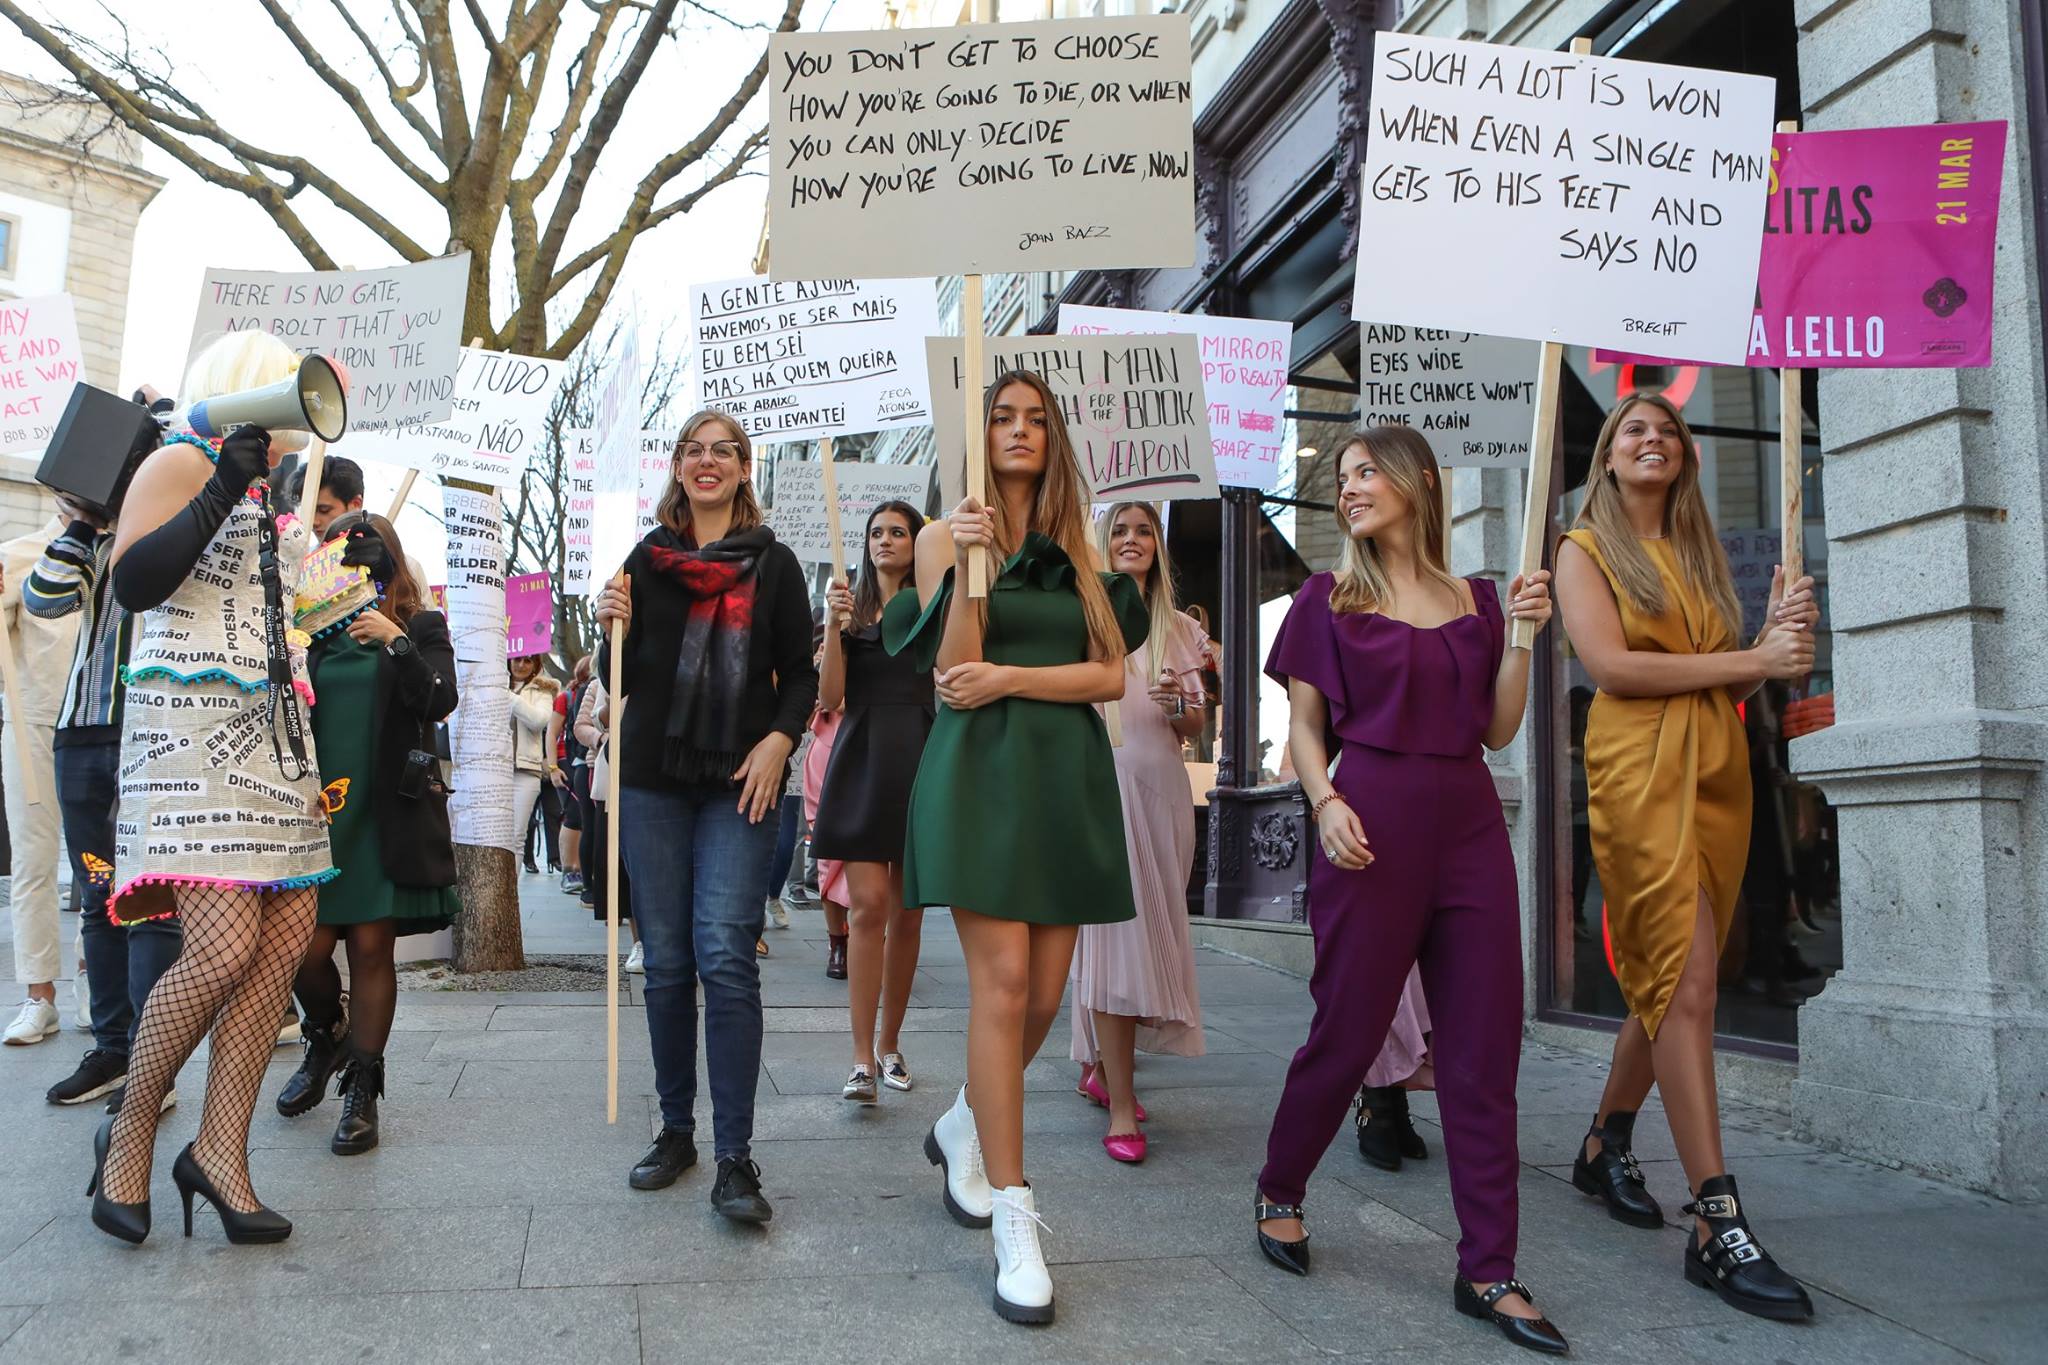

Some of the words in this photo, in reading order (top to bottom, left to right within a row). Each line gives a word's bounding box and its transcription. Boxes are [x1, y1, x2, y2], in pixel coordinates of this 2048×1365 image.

[782, 51, 832, 92] YOU
[851, 40, 935, 74] DON'T
[947, 40, 999, 67] GET
[1012, 37, 1036, 63] TO
[1054, 33, 1159, 60] CHOOSE
[1386, 48, 1466, 86] SUCH
[1478, 57, 1502, 93] A
[1517, 60, 1576, 100] LOT
[1590, 67, 1624, 106] IS
[1648, 78, 1720, 118] WON
[790, 91, 849, 123] HOW
[855, 88, 923, 126] YOU'RE
[936, 84, 998, 109] GOING
[1092, 82, 1121, 103] OR
[1128, 80, 1190, 103] WHEN
[786, 138, 831, 168] YOU
[846, 134, 894, 155] CAN
[907, 129, 966, 161] ONLY
[980, 119, 1070, 147] DECIDE
[1380, 104, 1457, 145] WHEN
[1470, 116, 1539, 156] EVEN
[1553, 128, 1574, 161] A
[1593, 134, 1695, 172] SINGLE
[1712, 150, 1762, 181] MAN
[1938, 137, 1973, 189] MAR
[791, 172, 849, 208] HOW
[860, 165, 936, 208] YOU'RE
[959, 157, 1034, 187] GOING
[1044, 154, 1073, 178] TO
[1372, 165, 1430, 202] GETS
[1445, 167, 1480, 203] TO
[1496, 172, 1542, 206] HIS
[1559, 175, 1630, 212] FEET
[1651, 197, 1721, 226] AND
[1936, 201, 1967, 225] 21
[1019, 232, 1053, 250] JOAN
[1559, 229, 1638, 271] SAYS
[1654, 236, 1696, 273] NO
[211, 281, 274, 306] THERE
[284, 285, 306, 304] IS
[313, 285, 343, 307] NO
[701, 292, 712, 315] A
[721, 282, 785, 311] GENTE
[271, 318, 326, 336] BOLT
[337, 310, 394, 339] THAT
[398, 309, 441, 339] YOU
[700, 316, 771, 341] HAVEMOS
[779, 313, 797, 330] DE
[808, 306, 838, 323] SER
[853, 295, 897, 317] MAIS
[1622, 318, 1687, 336] BRECHT
[1368, 325, 1406, 343] AND
[1786, 316, 1883, 359] LELLO
[19, 338, 60, 361] AND
[389, 342, 424, 368] THE
[703, 348, 724, 370] EU
[734, 341, 768, 364] BEM
[776, 331, 802, 357] SEI
[1203, 336, 1282, 362] MIRROR
[1371, 353, 1408, 375] EYES
[1418, 348, 1463, 371] WIDE
[35, 361, 77, 381] WAY
[473, 355, 548, 394] TUDO
[704, 375, 744, 398] MAS
[753, 363, 776, 389] HÁ
[783, 360, 830, 384] QUEM
[839, 348, 896, 375] QUEIRA
[1103, 347, 1179, 384] MAN
[364, 383, 395, 413] MY
[405, 376, 453, 402] MIND
[879, 388, 911, 400] ZECA
[1217, 363, 1235, 384] TO
[1240, 367, 1287, 401] REALITY
[1366, 383, 1405, 405] THE
[1410, 382, 1475, 402] CHANCE
[1481, 381, 1534, 404] WON'T
[5, 396, 42, 419] ACT
[754, 393, 796, 411] ABAIXO
[877, 401, 919, 415] AFONSO
[1090, 393, 1116, 408] FOR
[1124, 390, 1196, 430] BOOK
[352, 418, 387, 431] VIRGINIA
[396, 411, 431, 427] WOOLF
[755, 417, 771, 431] EU
[779, 402, 845, 428] LEVANTEI
[1092, 410, 1112, 420] THE
[1423, 411, 1469, 430] AGAIN
[477, 419, 523, 453] NÃO
[1087, 435, 1190, 483] WEAPON
[1258, 446, 1280, 463] IT
[1463, 442, 1483, 455] BOB
[1488, 442, 1528, 457] DYLAN
[473, 461, 509, 474] SANTOS
[573, 479, 593, 492] THE
[226, 527, 258, 539] mais
[569, 518, 588, 529] AND
[212, 542, 244, 560] SER
[569, 551, 588, 562] FOR
[219, 560, 239, 574] SÊ
[568, 570, 583, 580] ARE
[520, 583, 528, 592] 21
[531, 580, 544, 591] MAR
[172, 697, 194, 708] DA
[200, 697, 239, 709] VIDA
[132, 731, 168, 744] Amigo
[204, 731, 227, 750] EM
[227, 702, 267, 731] TODAS
[148, 742, 175, 760] que
[179, 738, 189, 747] o
[209, 751, 229, 768] AS
[228, 725, 255, 750] RUAS
[234, 733, 263, 766] PERCO
[121, 780, 200, 794] pensamento
[228, 774, 305, 809] DICHTKUNST
[152, 814, 171, 827] Já
[176, 814, 206, 828] que
[211, 813, 231, 822] se
[148, 843, 177, 855] não
[184, 842, 203, 851] se
[211, 841, 287, 855] esmaguem
[289, 845, 306, 854] com
